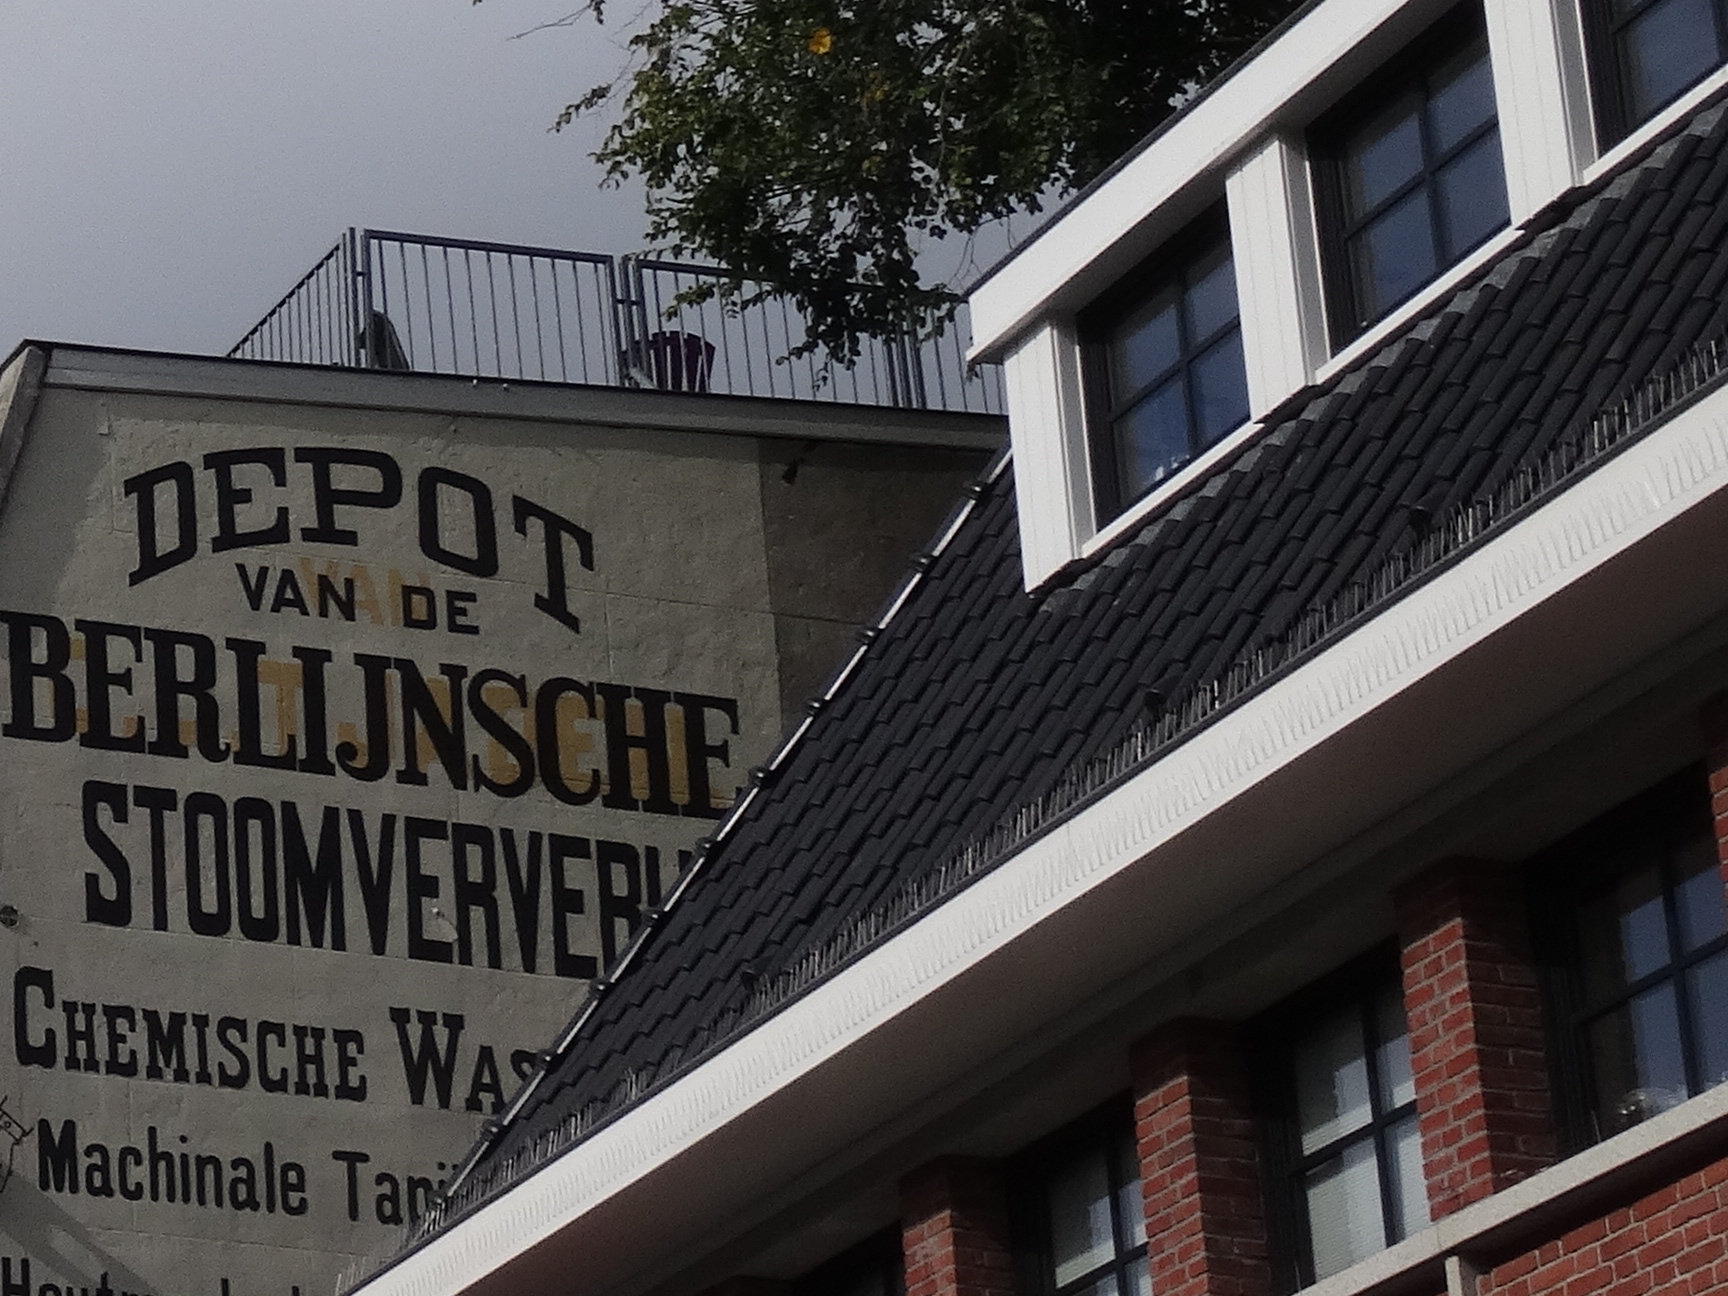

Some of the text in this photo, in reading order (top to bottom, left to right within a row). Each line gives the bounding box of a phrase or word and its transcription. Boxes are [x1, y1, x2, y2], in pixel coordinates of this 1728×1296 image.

[126, 446, 594, 634] DEPOT
[235, 562, 480, 635] VAN DE
[0, 610, 744, 819] BERLIJNSCHE
[13, 966, 368, 1102] CHEMISCHE
[37, 1119, 308, 1216] Machinale
